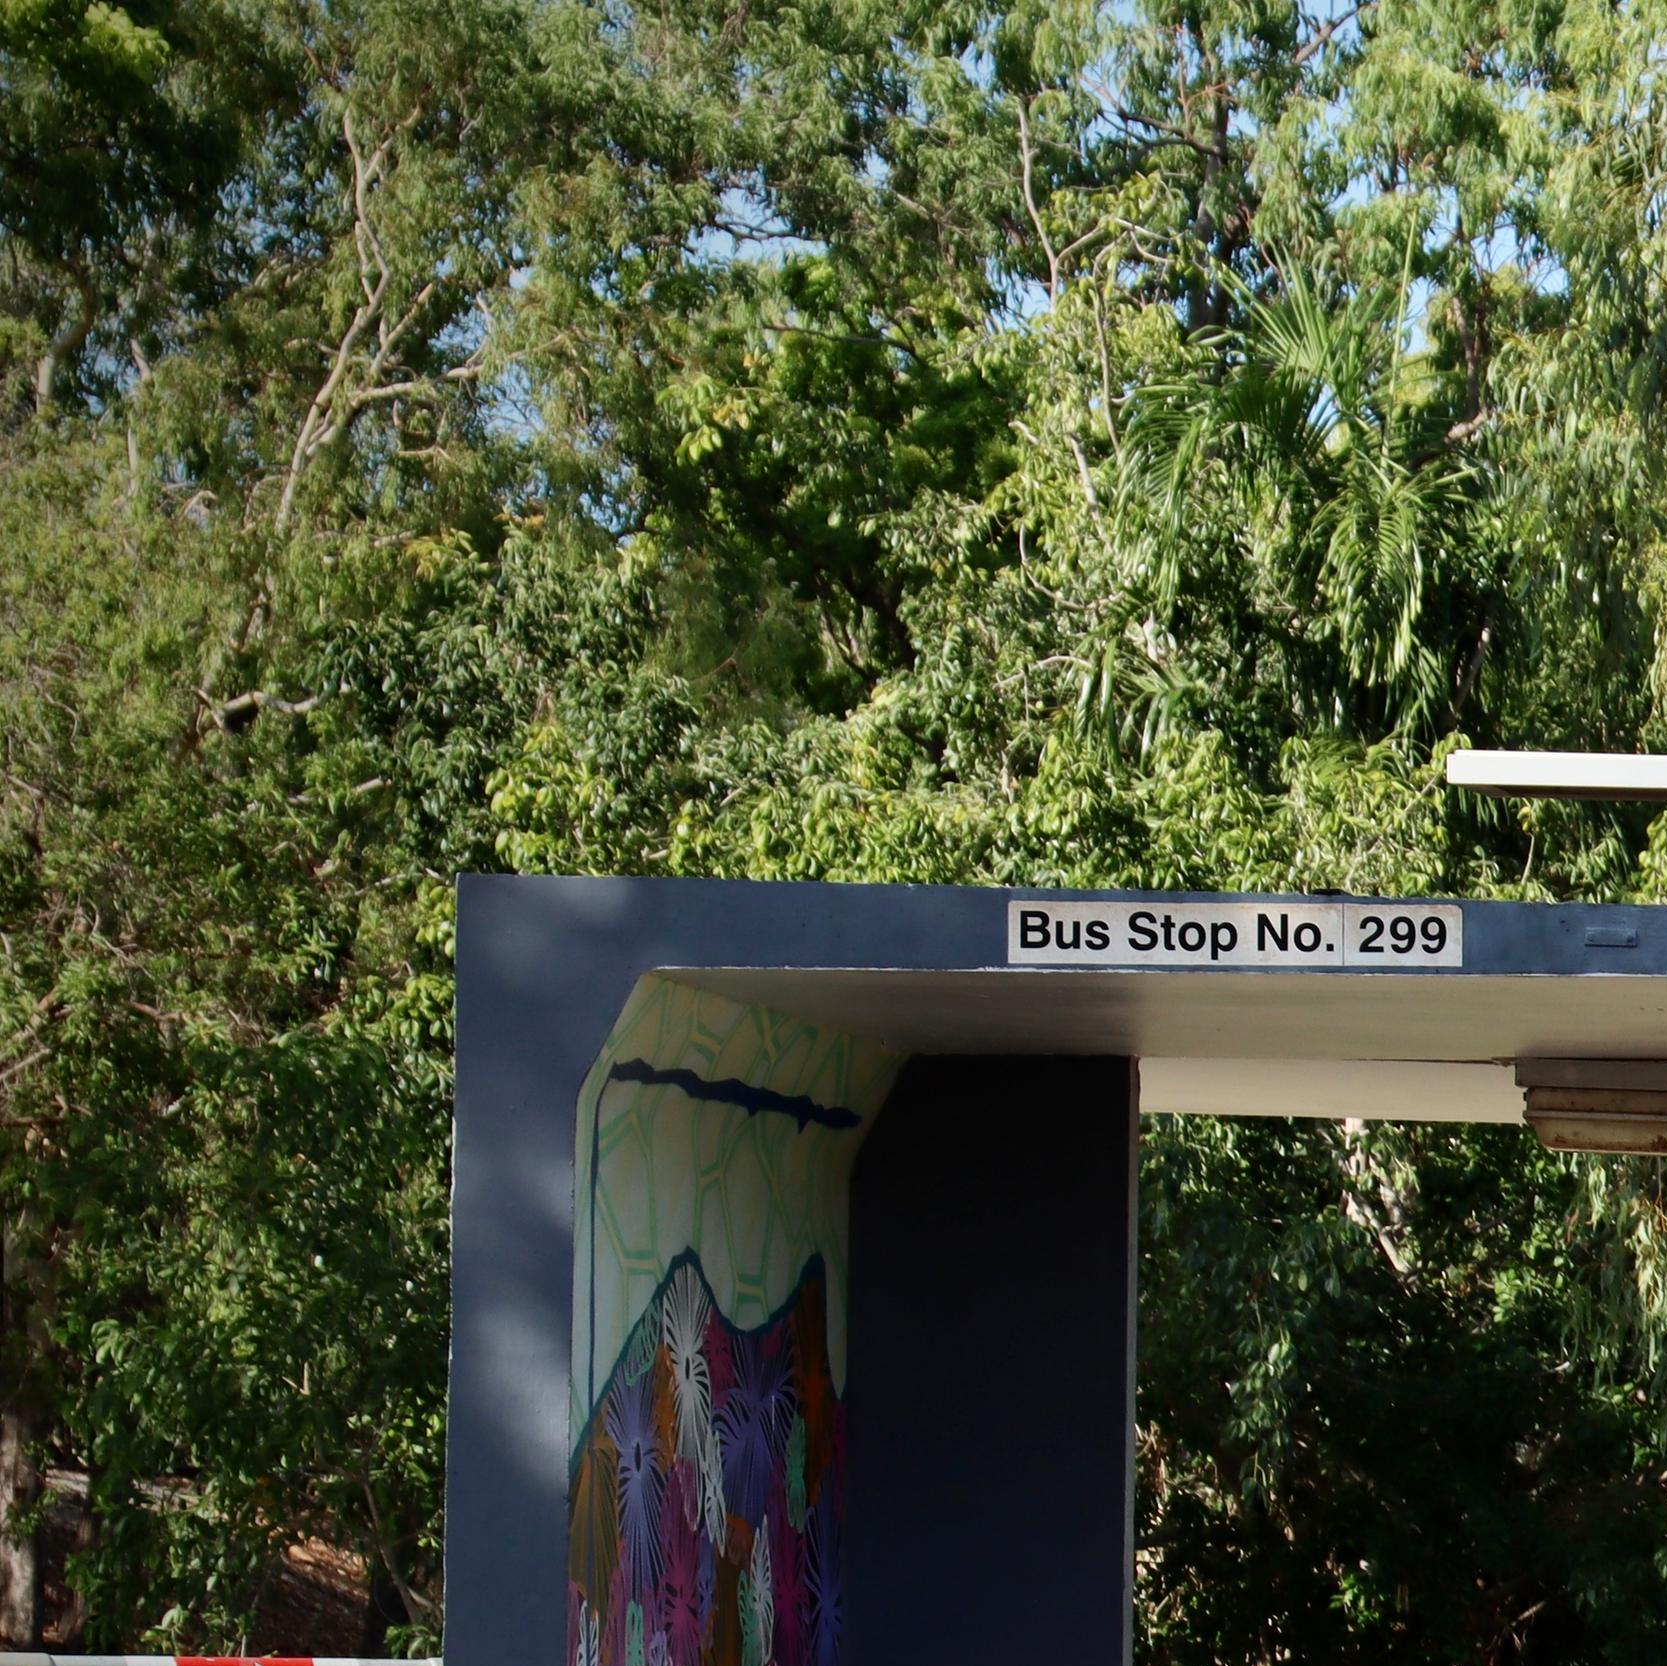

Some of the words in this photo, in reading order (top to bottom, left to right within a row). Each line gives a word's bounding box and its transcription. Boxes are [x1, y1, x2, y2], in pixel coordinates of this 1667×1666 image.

[1019, 910, 1110, 950] Bus
[1128, 911, 1238, 960] Stop
[1257, 913, 1335, 953] No.
[1358, 915, 1447, 954] 299
